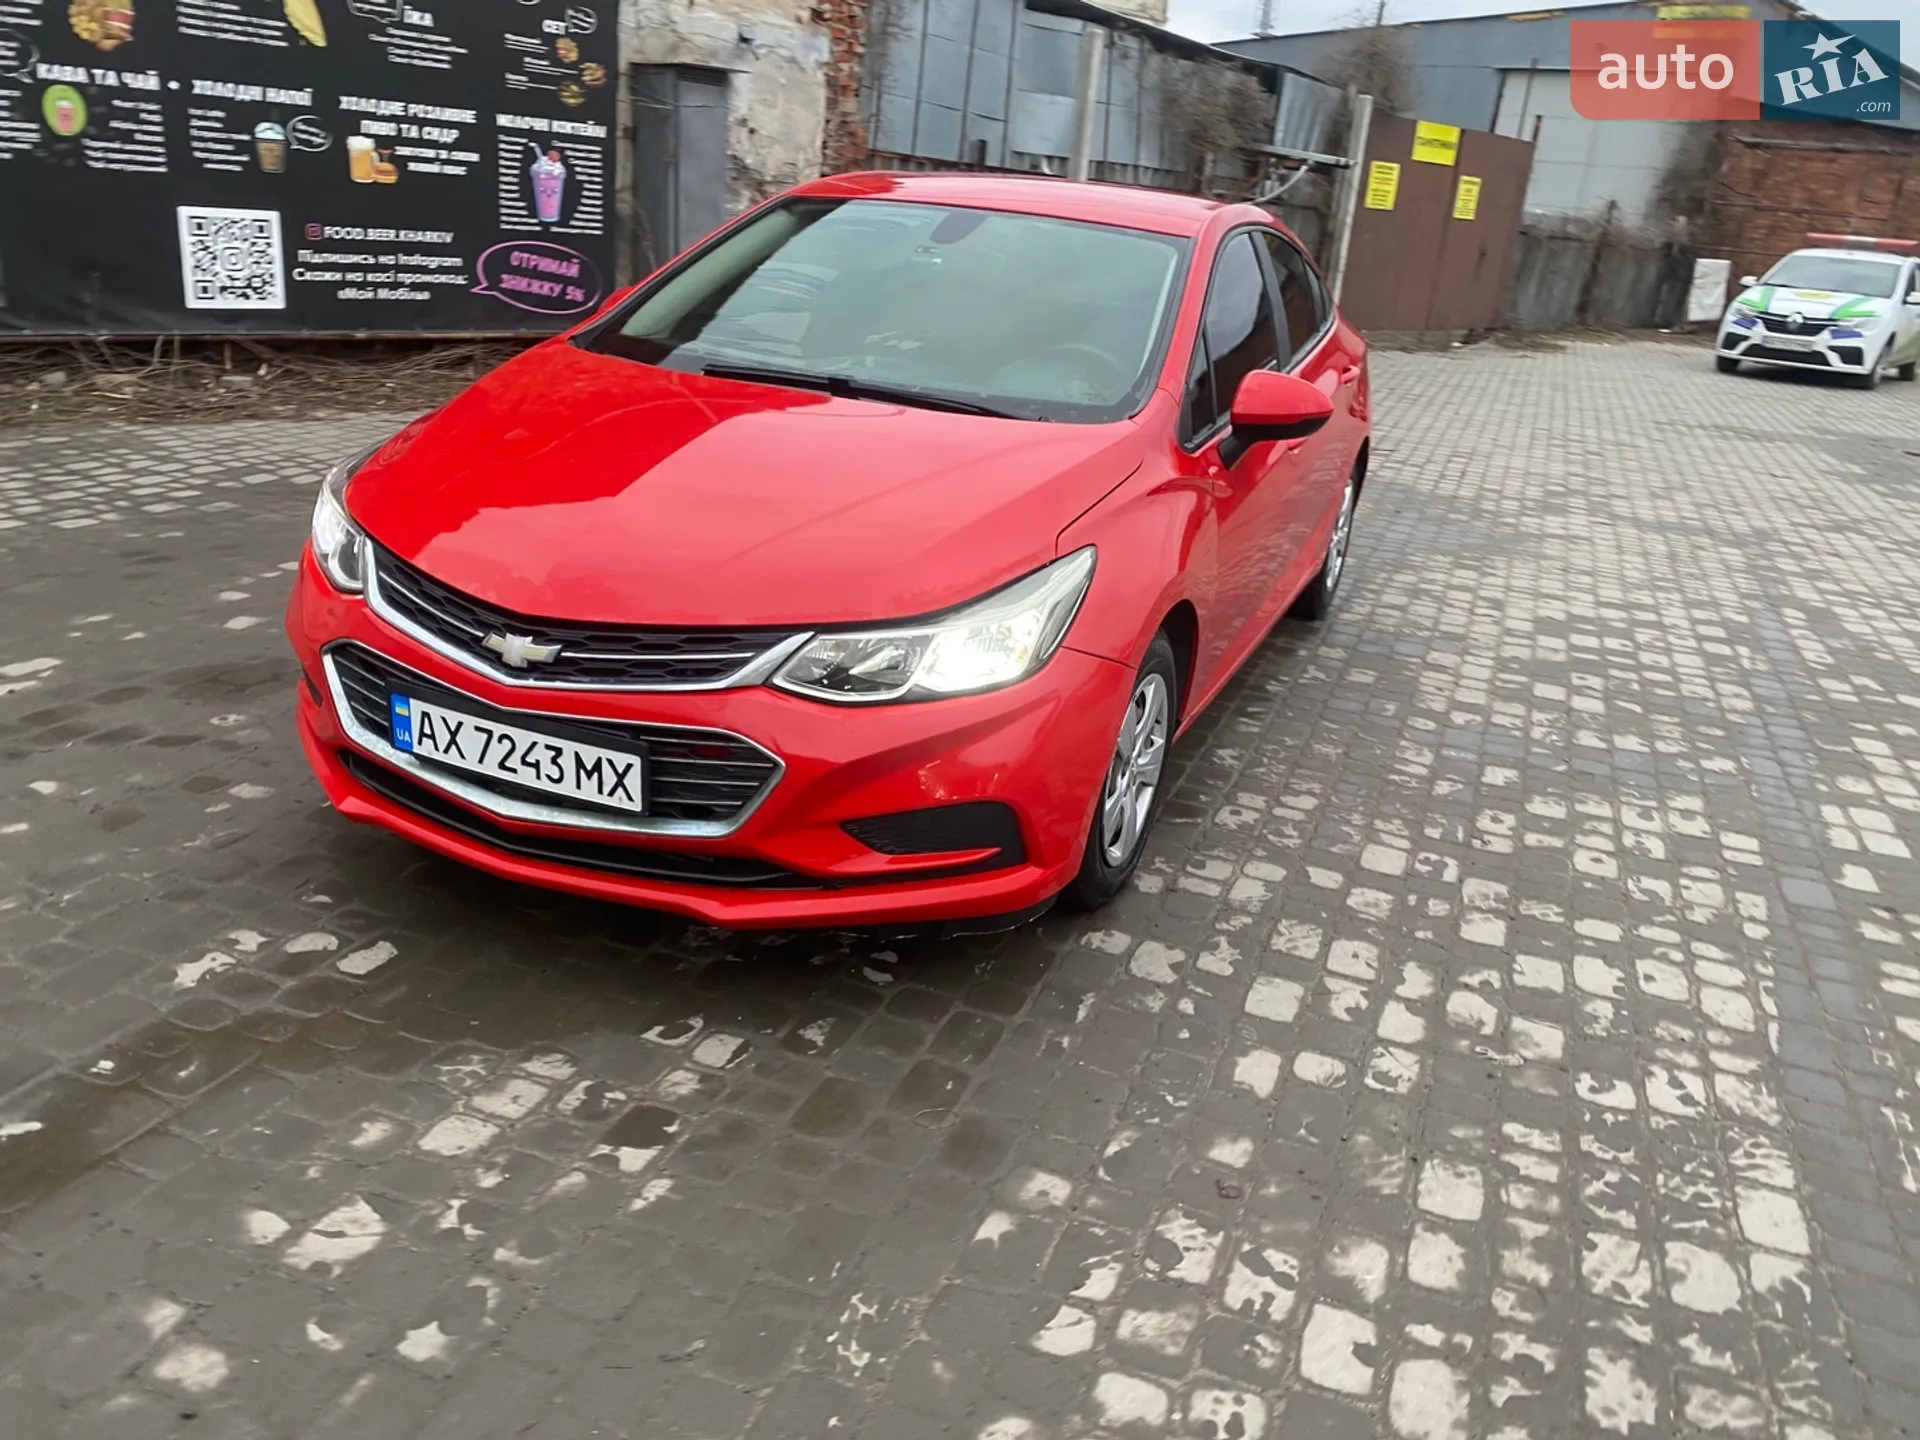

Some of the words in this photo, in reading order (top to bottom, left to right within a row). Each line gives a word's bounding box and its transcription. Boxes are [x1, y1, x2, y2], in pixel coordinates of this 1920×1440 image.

[36, 63, 90, 84] КАВА
[91, 69, 120, 87] ТА
[121, 70, 161, 91] ЧАЙ
[360, 120, 399, 136] ПИВО
[399, 124, 420, 139] ТА
[421, 126, 460, 144] СИДР
[323, 226, 454, 243] FOOD.BEER.KHARKIV
[378, 255, 396, 265] на
[397, 252, 463, 269] Instagram
[510, 250, 580, 278] ОТРИМАЙ
[344, 271, 365, 282] на
[499, 273, 563, 297] ЗНИЖКУ
[565, 285, 586, 302] 5%
[396, 728, 411, 744] UA
[417, 711, 466, 760] AX
[473, 725, 565, 784] 7243
[573, 750, 635, 803] MX
